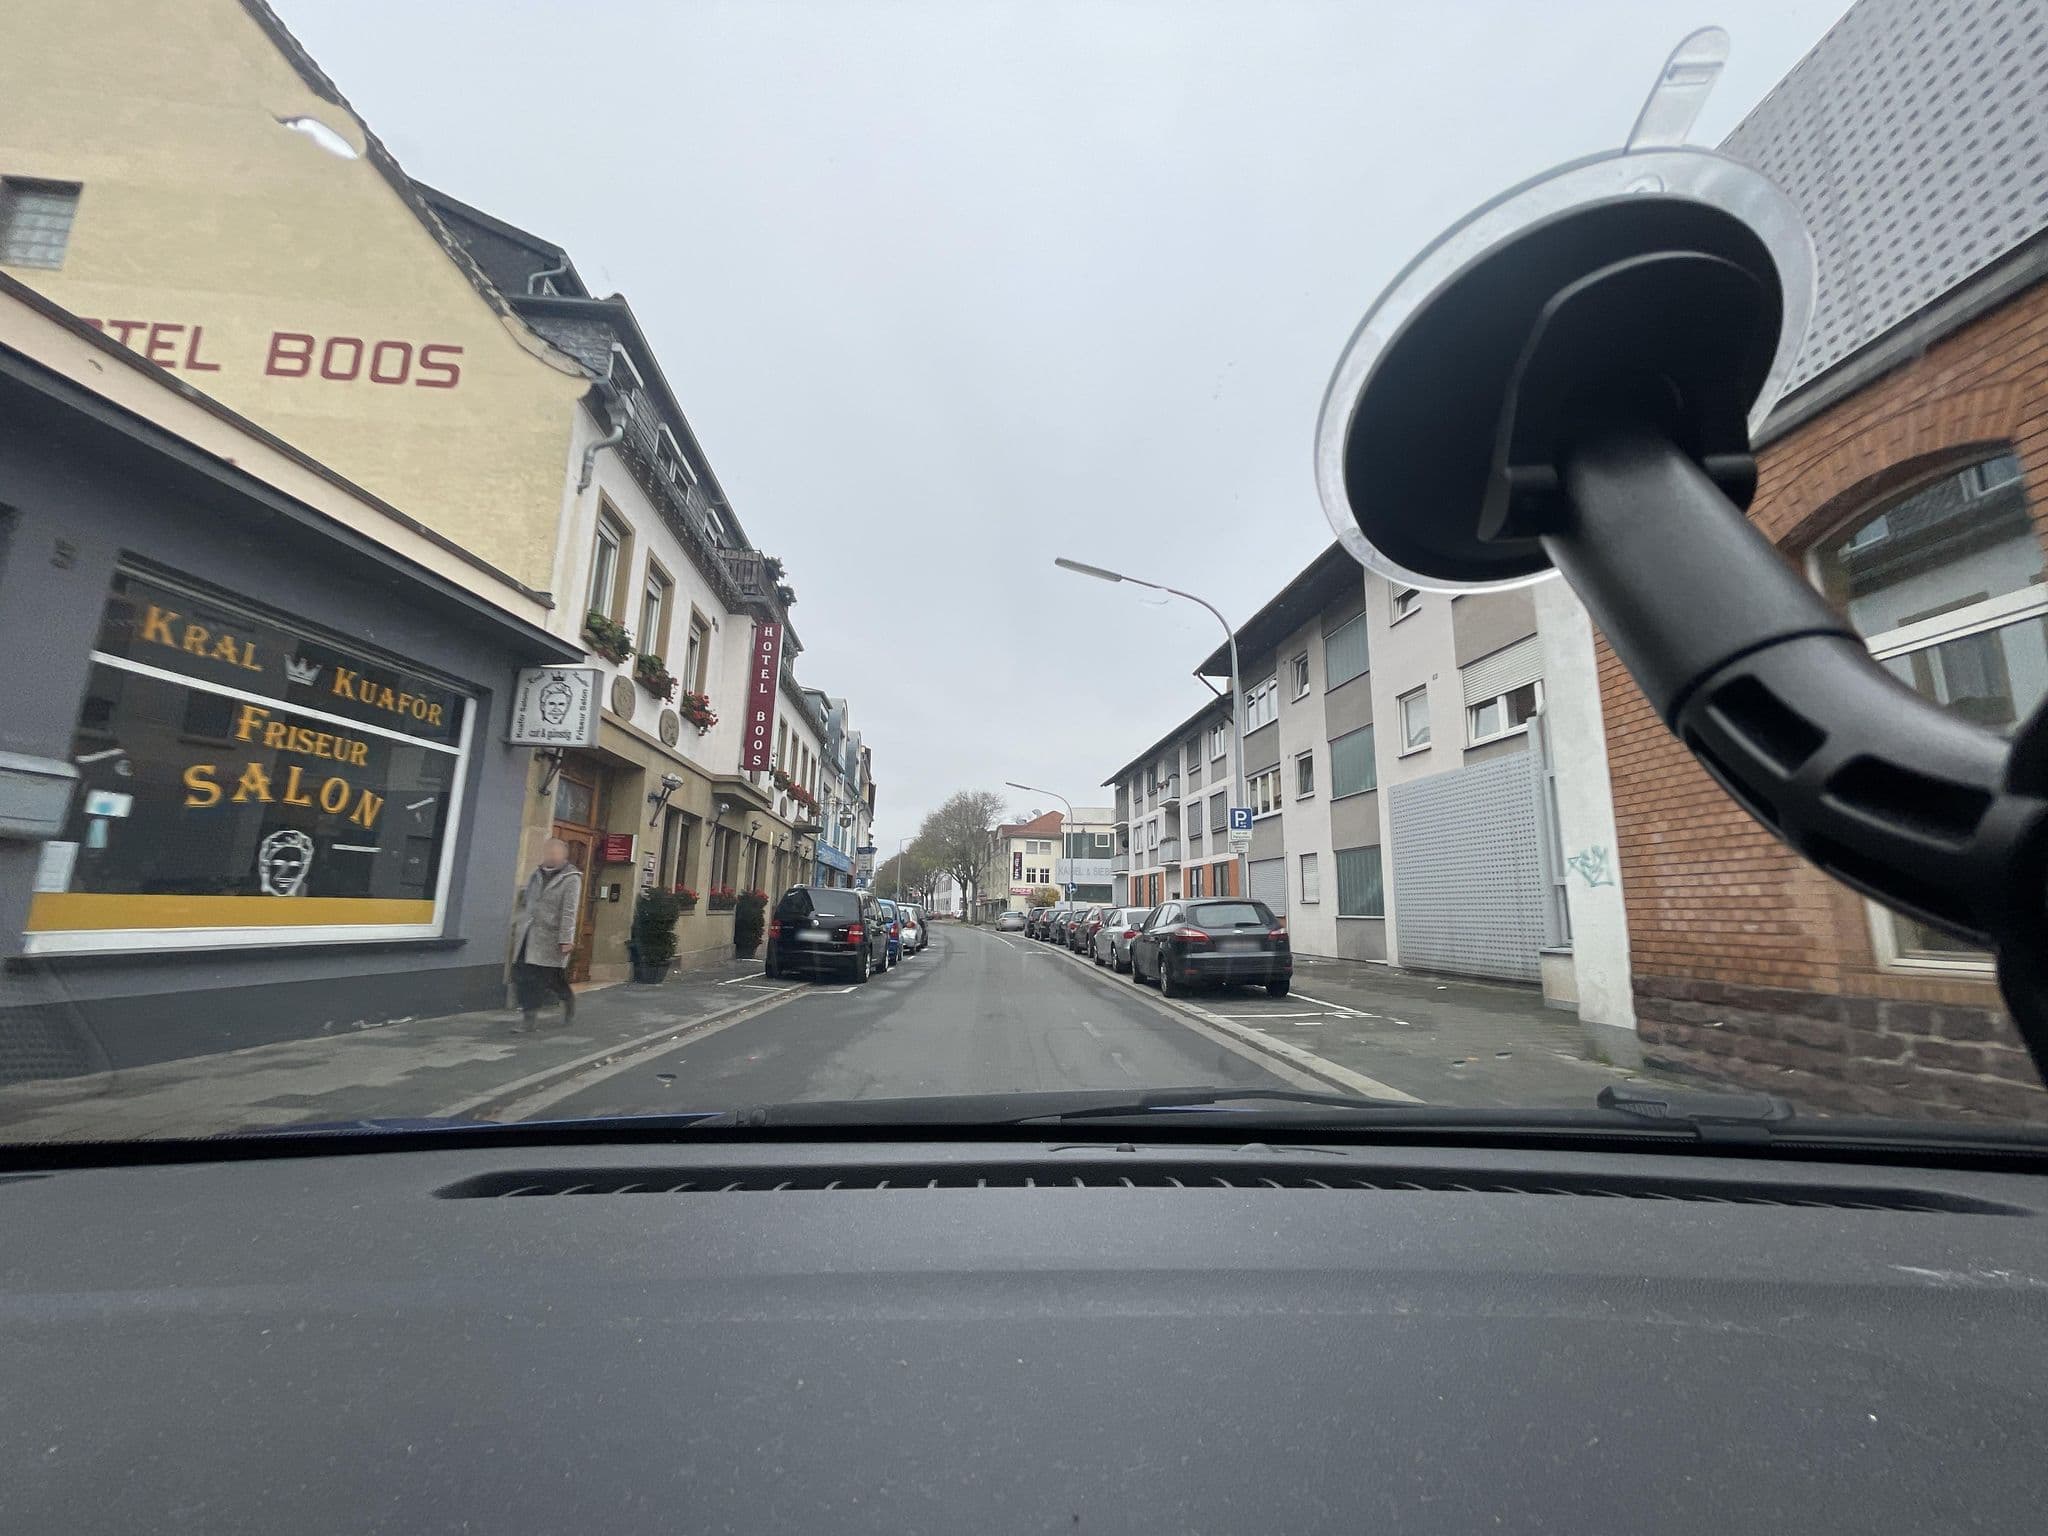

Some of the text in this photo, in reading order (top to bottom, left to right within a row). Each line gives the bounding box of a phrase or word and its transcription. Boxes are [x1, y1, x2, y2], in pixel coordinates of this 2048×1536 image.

[265, 332, 464, 390] BOOS
[142, 605, 264, 672] KRAL
[759, 626, 773, 693] HOTEL
[234, 704, 369, 767] FRISEUR
[752, 711, 766, 766] BOOS
[183, 762, 385, 830] SALON
[1235, 810, 1247, 827] P
